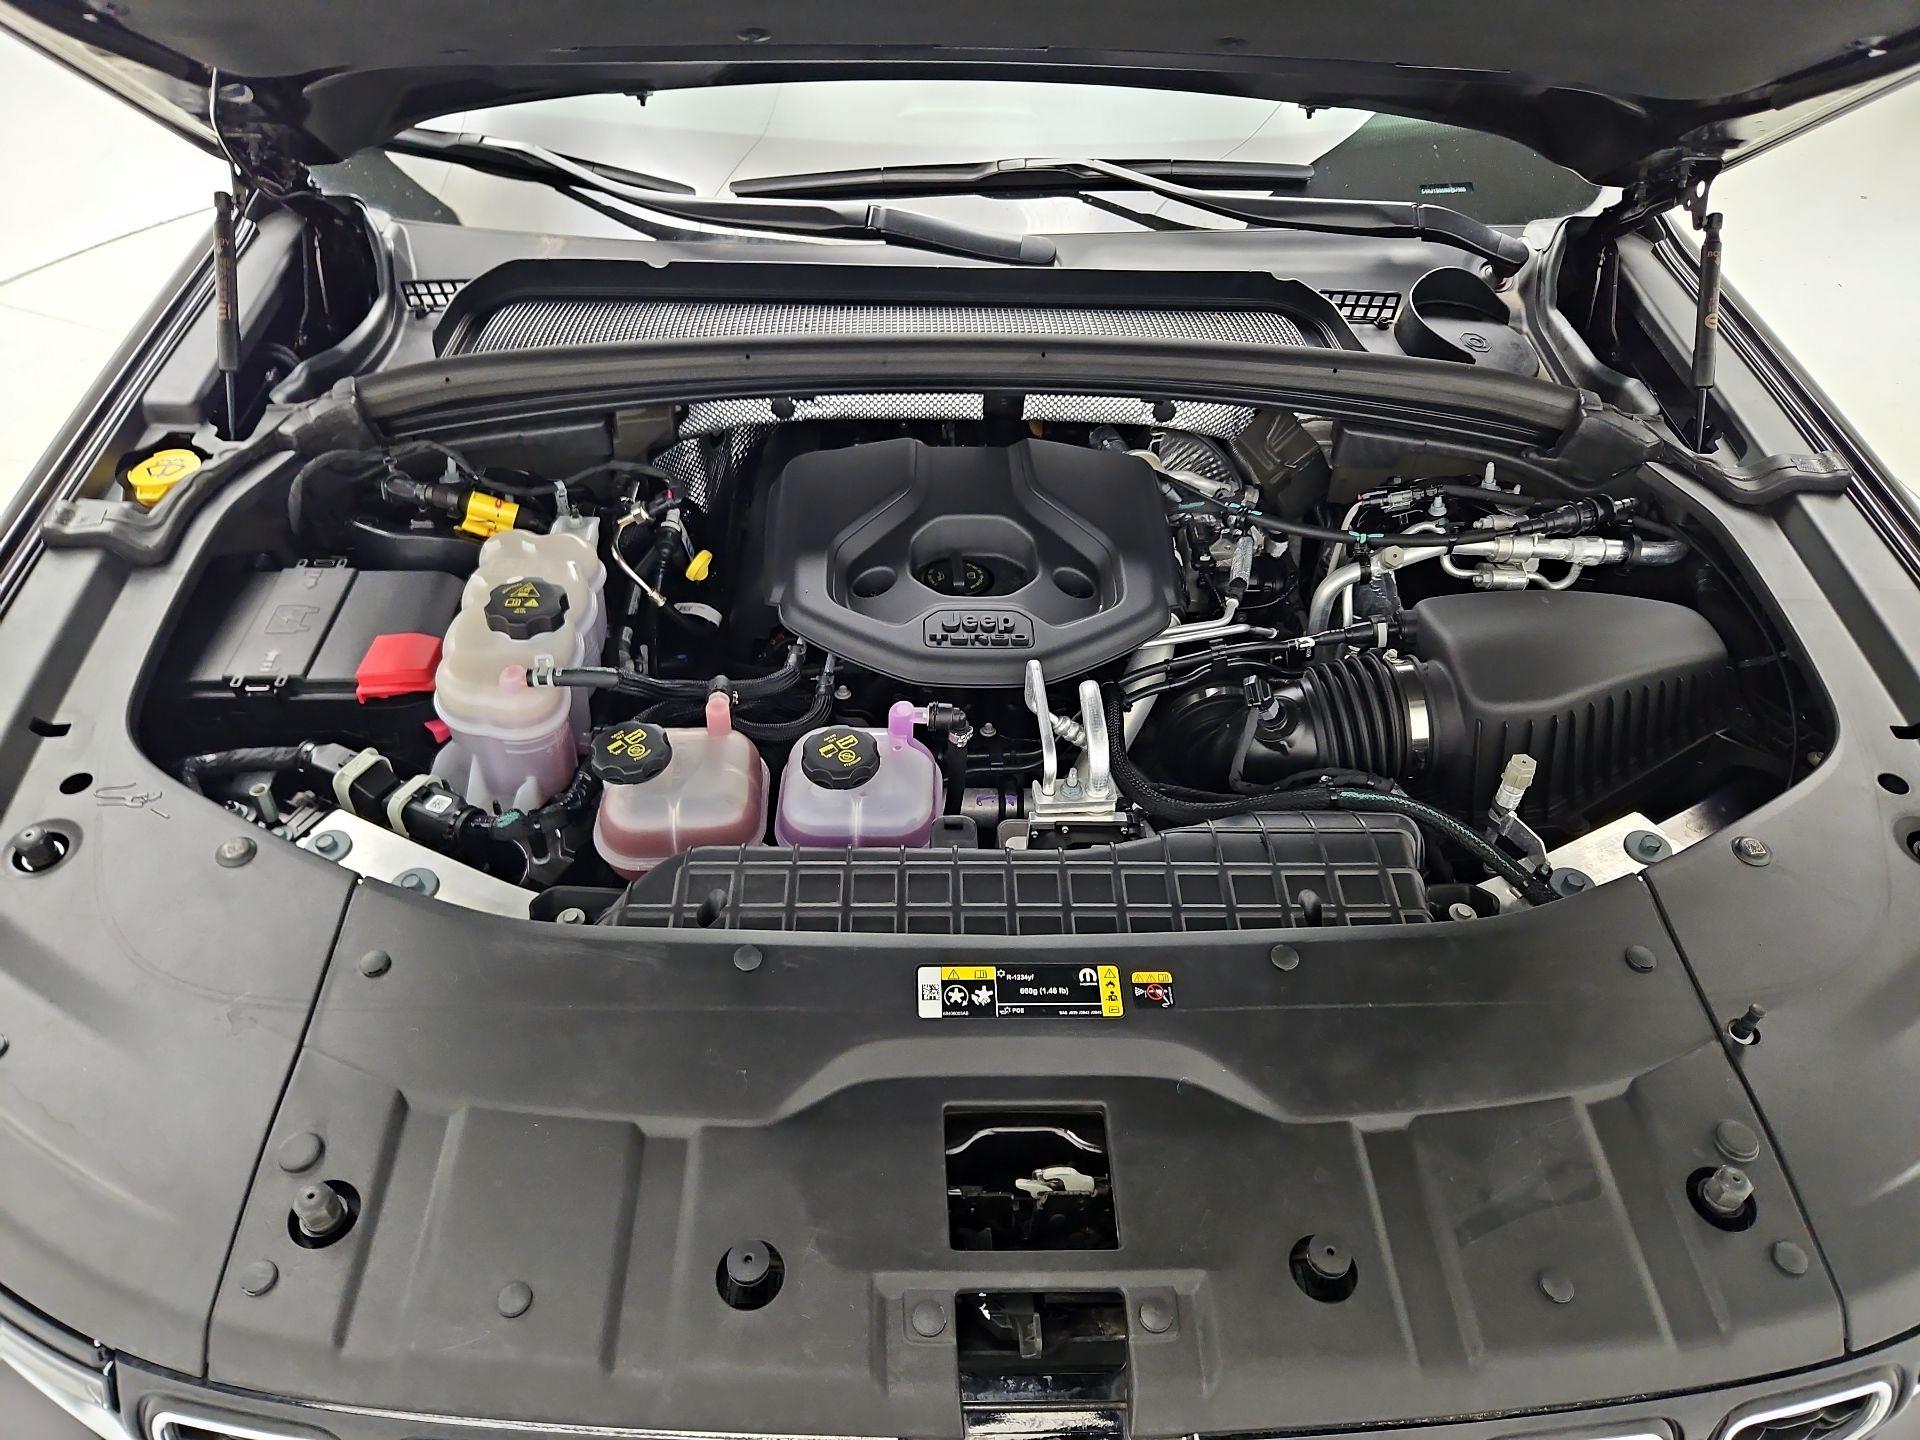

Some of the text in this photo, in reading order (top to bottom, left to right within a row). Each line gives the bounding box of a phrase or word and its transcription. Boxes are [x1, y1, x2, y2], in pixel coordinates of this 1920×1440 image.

[942, 611, 1015, 633] Jeep
[929, 634, 1029, 646] TURBO
[1006, 973, 1034, 982] R-1234yf
